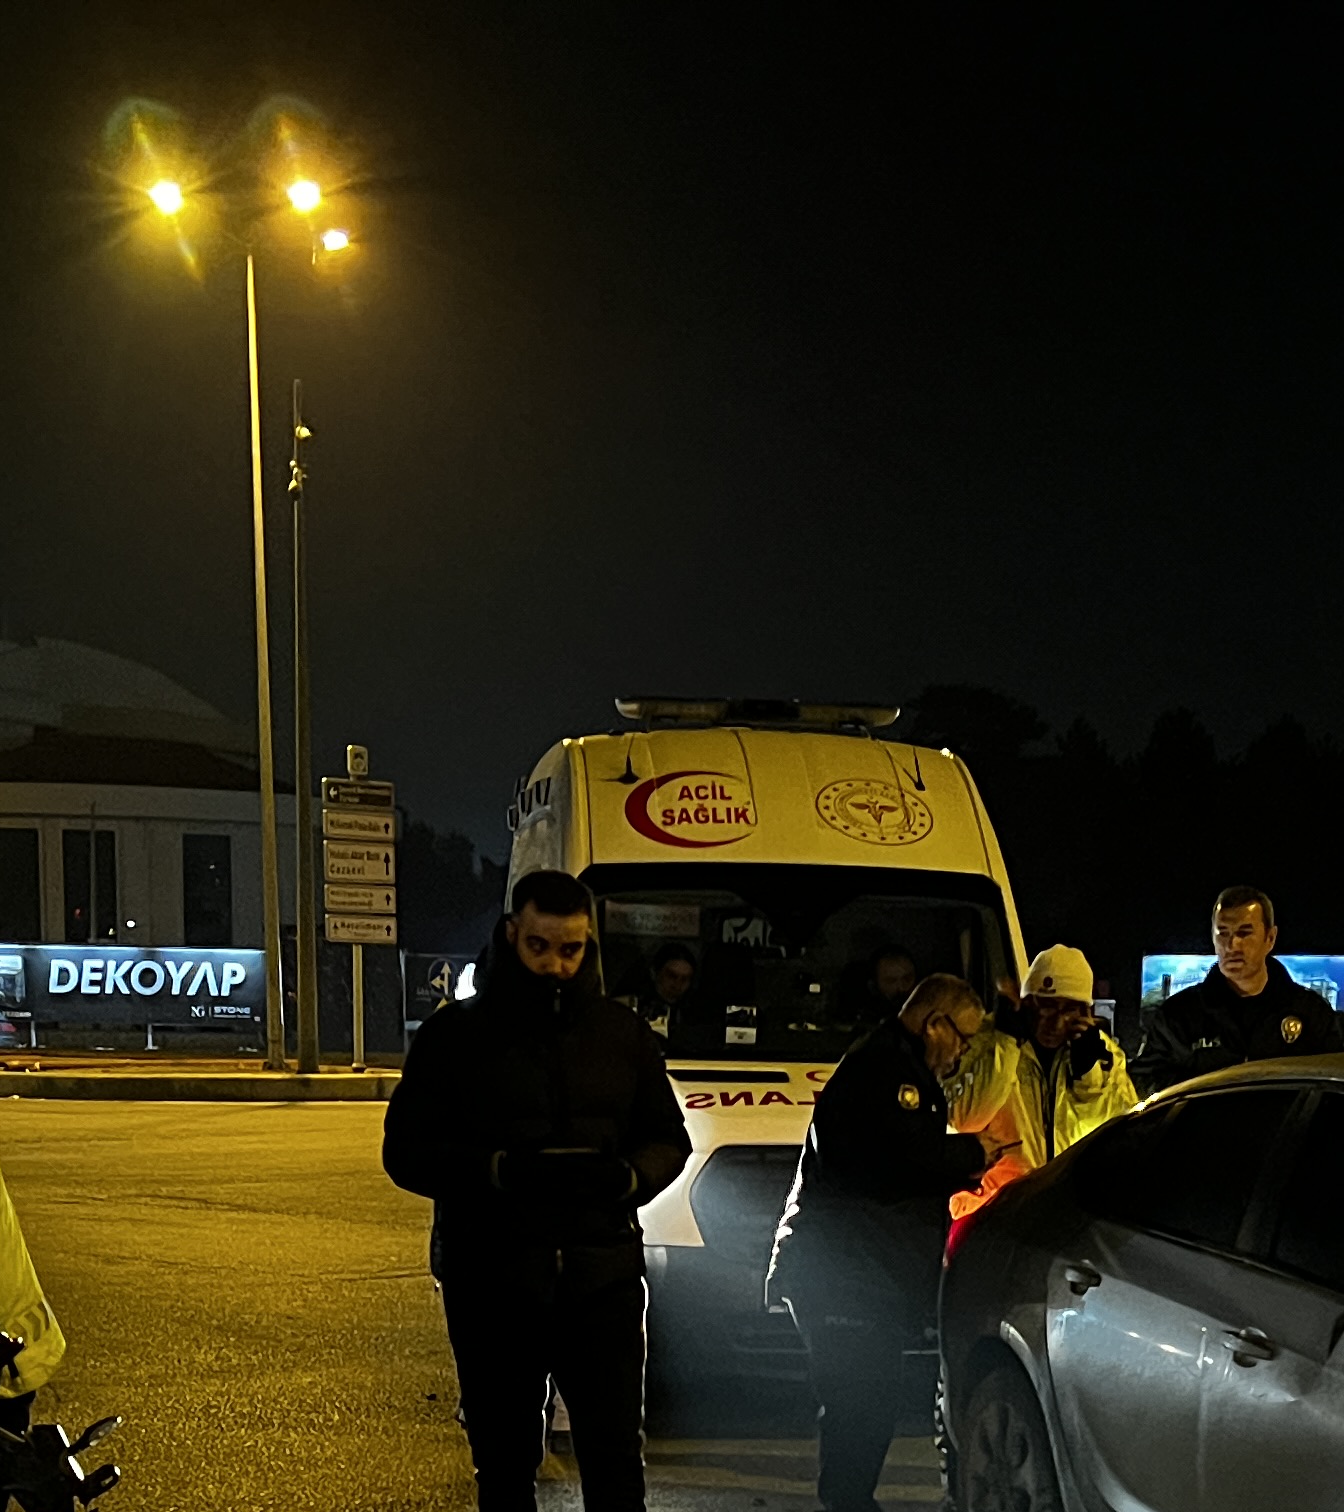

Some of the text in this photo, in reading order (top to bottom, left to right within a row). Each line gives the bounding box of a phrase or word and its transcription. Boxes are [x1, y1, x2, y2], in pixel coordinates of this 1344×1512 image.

[678, 780, 733, 801] ACİL
[662, 803, 751, 827] SAĞLIK
[48, 958, 246, 997] DEKOYAP
[213, 1006, 251, 1015] STONE
